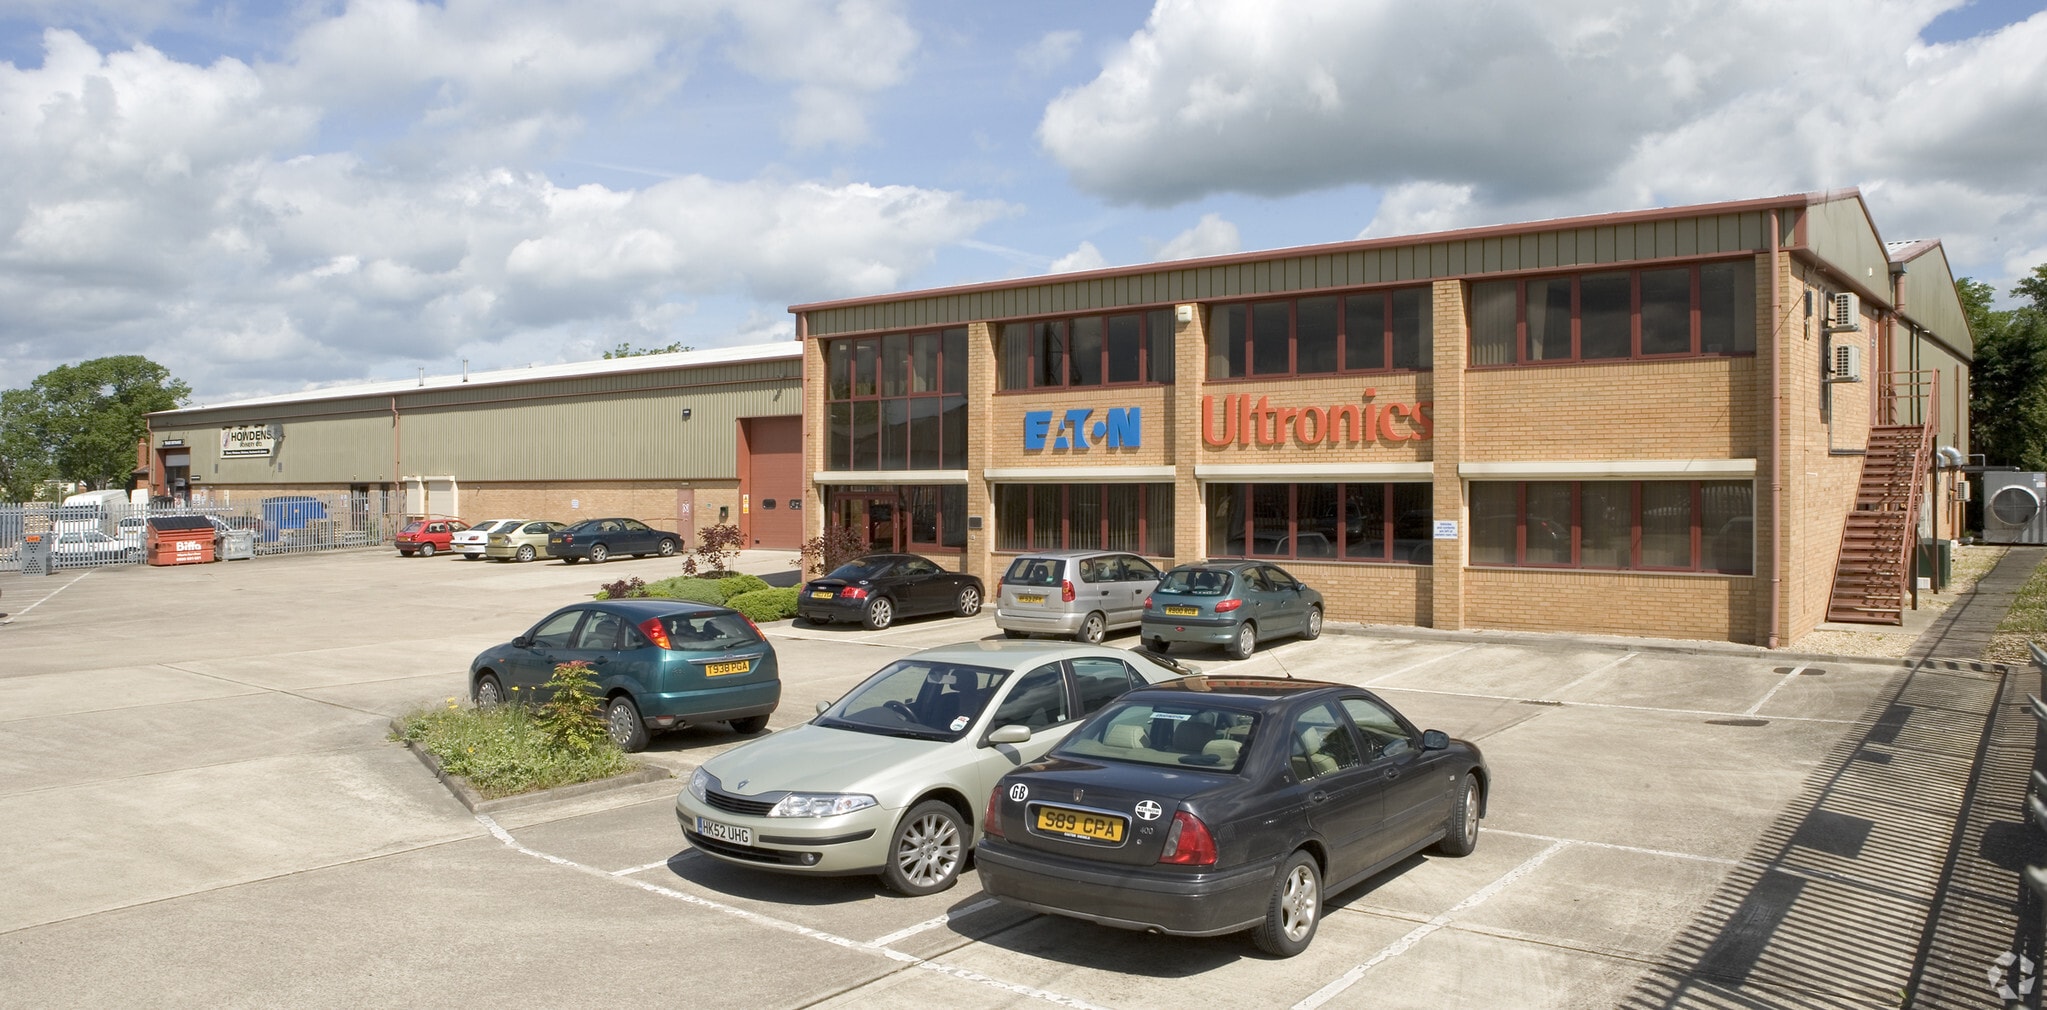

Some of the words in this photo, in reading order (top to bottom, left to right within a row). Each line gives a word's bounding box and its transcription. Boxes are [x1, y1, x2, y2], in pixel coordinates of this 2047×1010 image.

[1202, 387, 1433, 446] Ultronics
[231, 430, 272, 441] HOWDENS
[1025, 407, 1142, 449] EATON
[176, 541, 202, 551] Biffa
[707, 663, 730, 674] T938
[731, 662, 748, 672] PGA
[1012, 785, 1026, 800] GB
[703, 820, 726, 839] HK52
[728, 827, 749, 843] UHG
[1045, 811, 1077, 830] S89
[1083, 817, 1115, 837] CPA
[1140, 827, 1154, 835] 400
